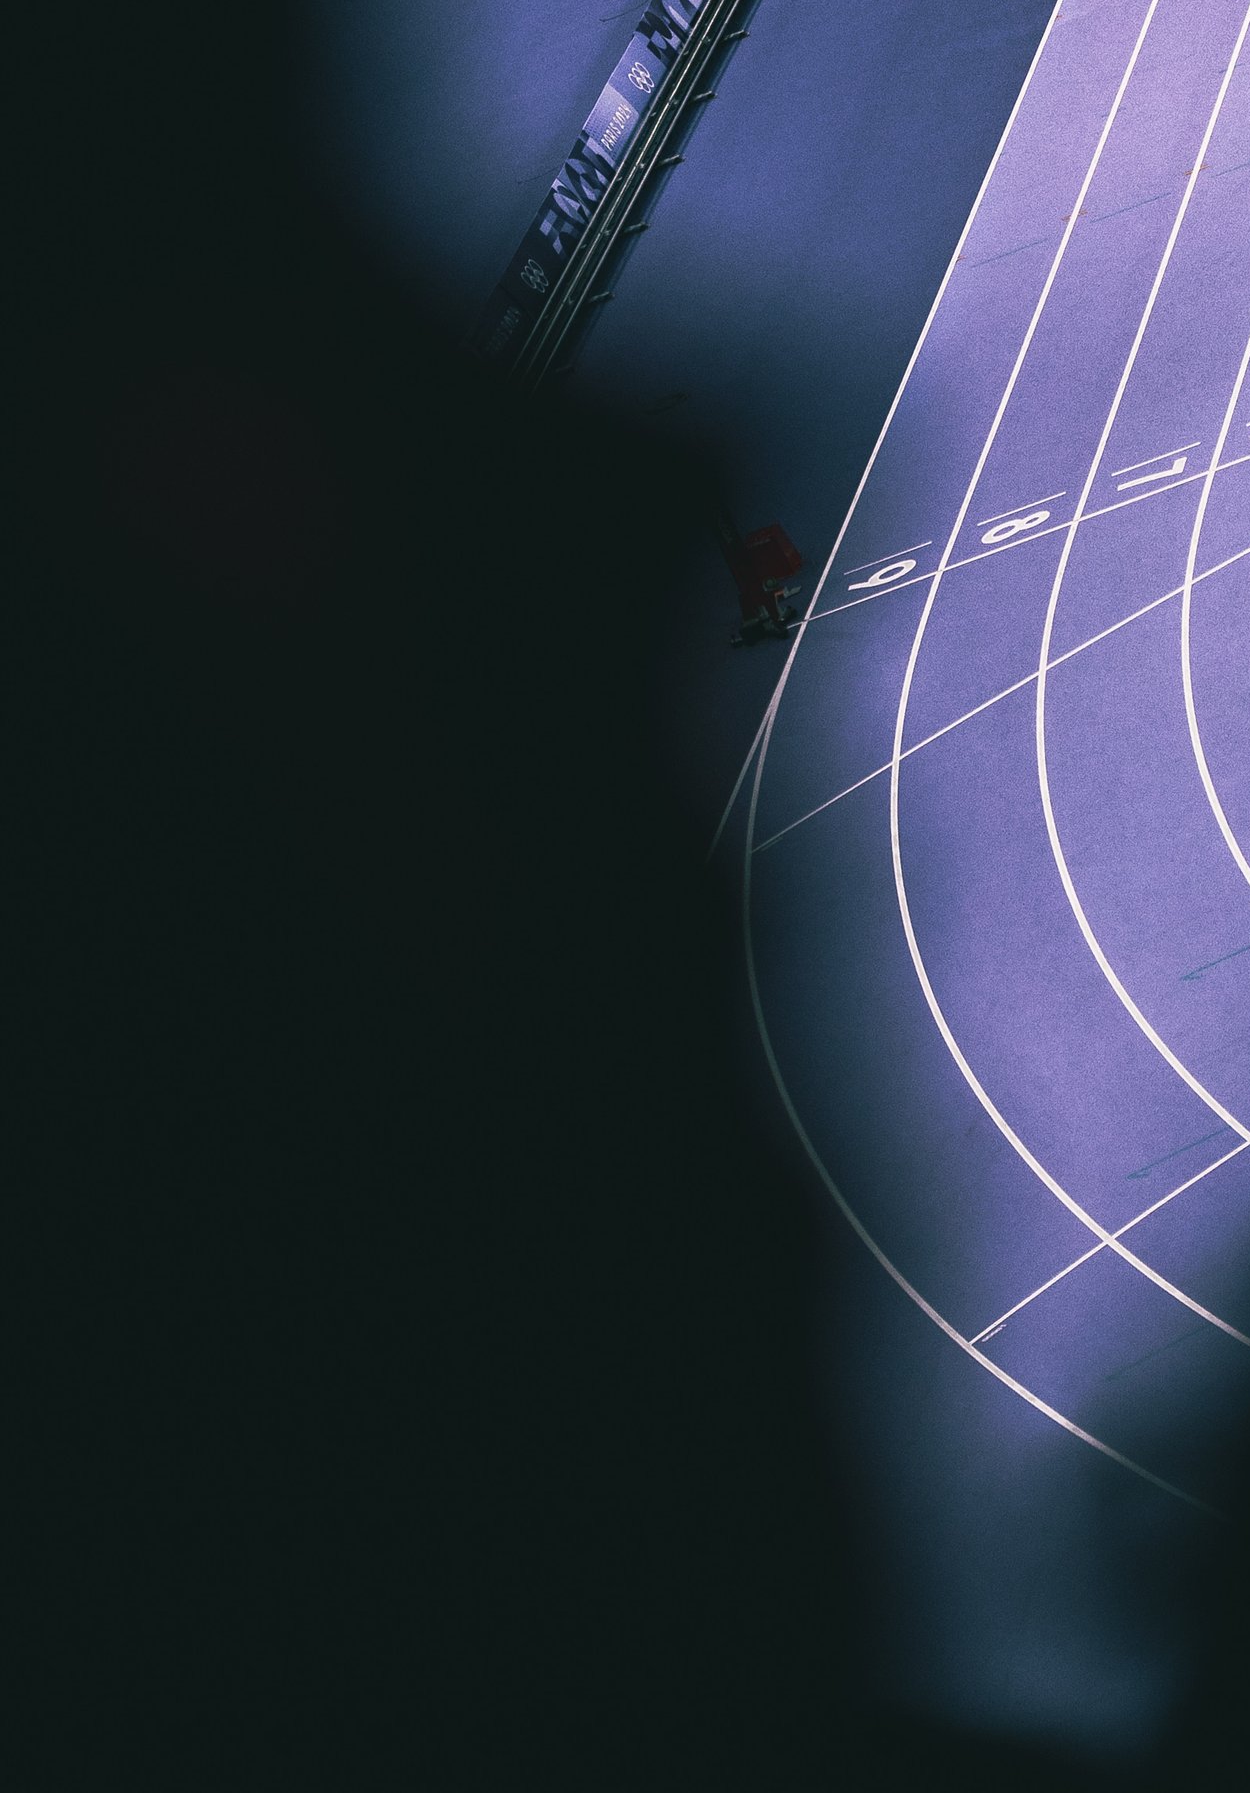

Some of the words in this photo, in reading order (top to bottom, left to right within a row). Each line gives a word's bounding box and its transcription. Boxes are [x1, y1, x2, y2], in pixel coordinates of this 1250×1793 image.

[612, 103, 632, 130] 2024
[1117, 456, 1189, 492] 7
[980, 510, 1051, 545] 8
[847, 559, 917, 592] 9
